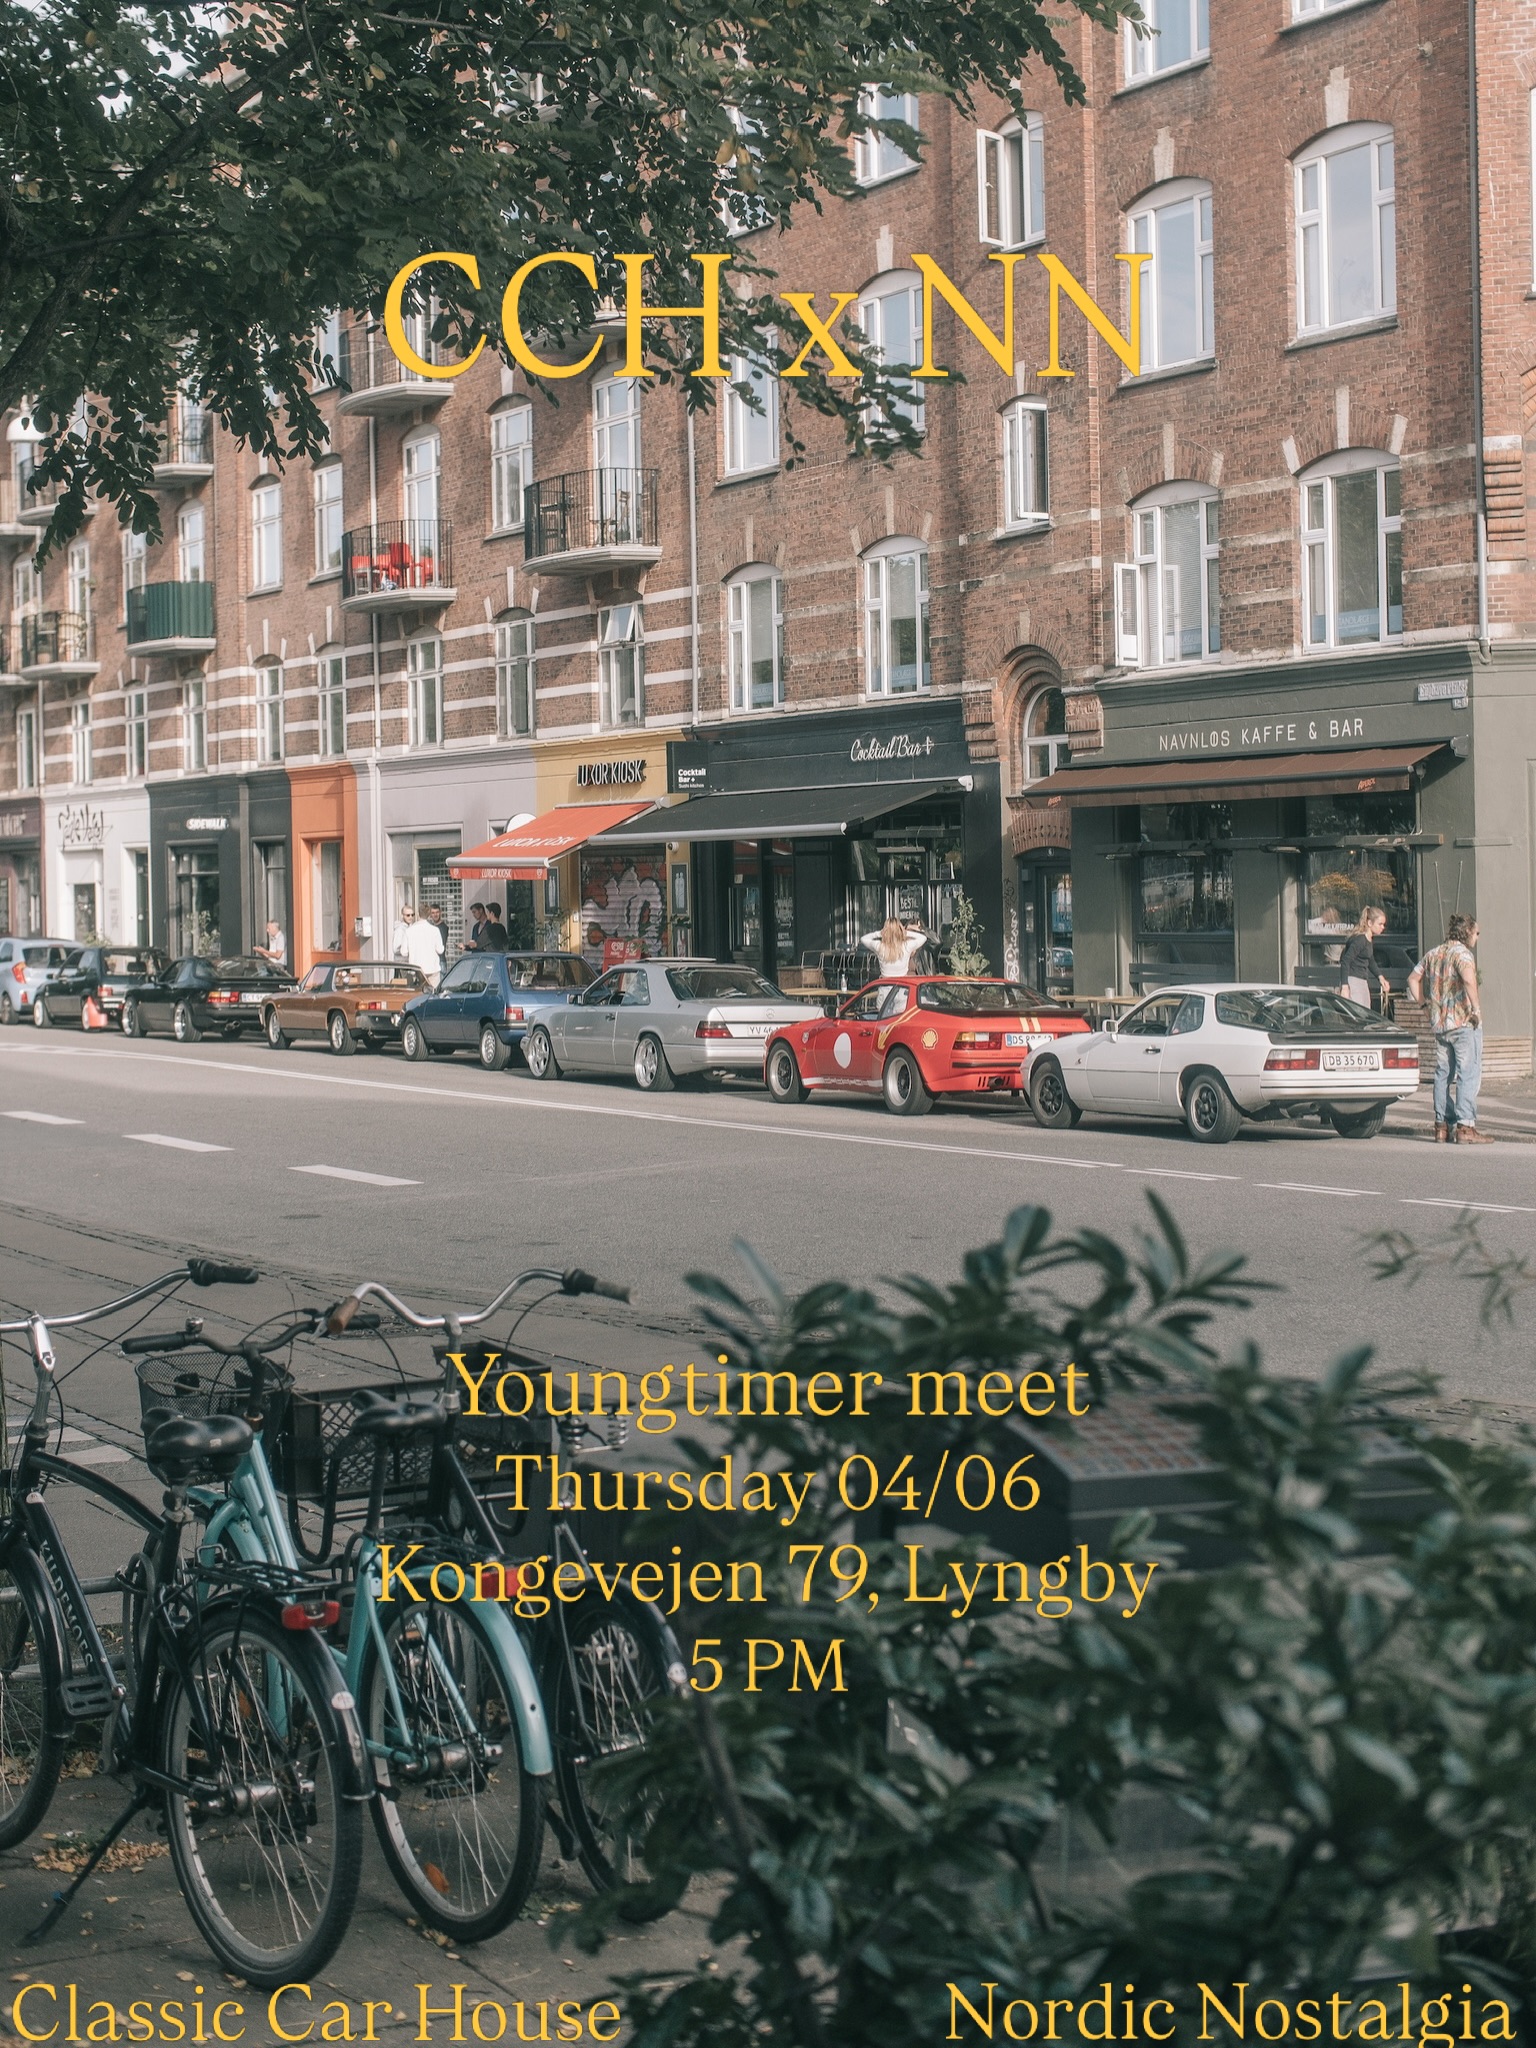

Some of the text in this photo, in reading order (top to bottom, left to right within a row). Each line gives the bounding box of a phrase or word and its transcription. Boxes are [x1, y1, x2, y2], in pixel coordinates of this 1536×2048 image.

[1159, 718, 1363, 751] NAVNLØS KAFFE & BAR
[850, 736, 896, 762] Cocktail
[896, 734, 922, 757] Bar
[577, 760, 644, 786] LUXOR KIOSK
[678, 767, 706, 776] Cocktail
[187, 817, 229, 830] SIDEWALK
[481, 868, 497, 878] LUXOR
[1012, 1035, 1024, 1045] DS
[1328, 1055, 1375, 1066] DB 35 670
